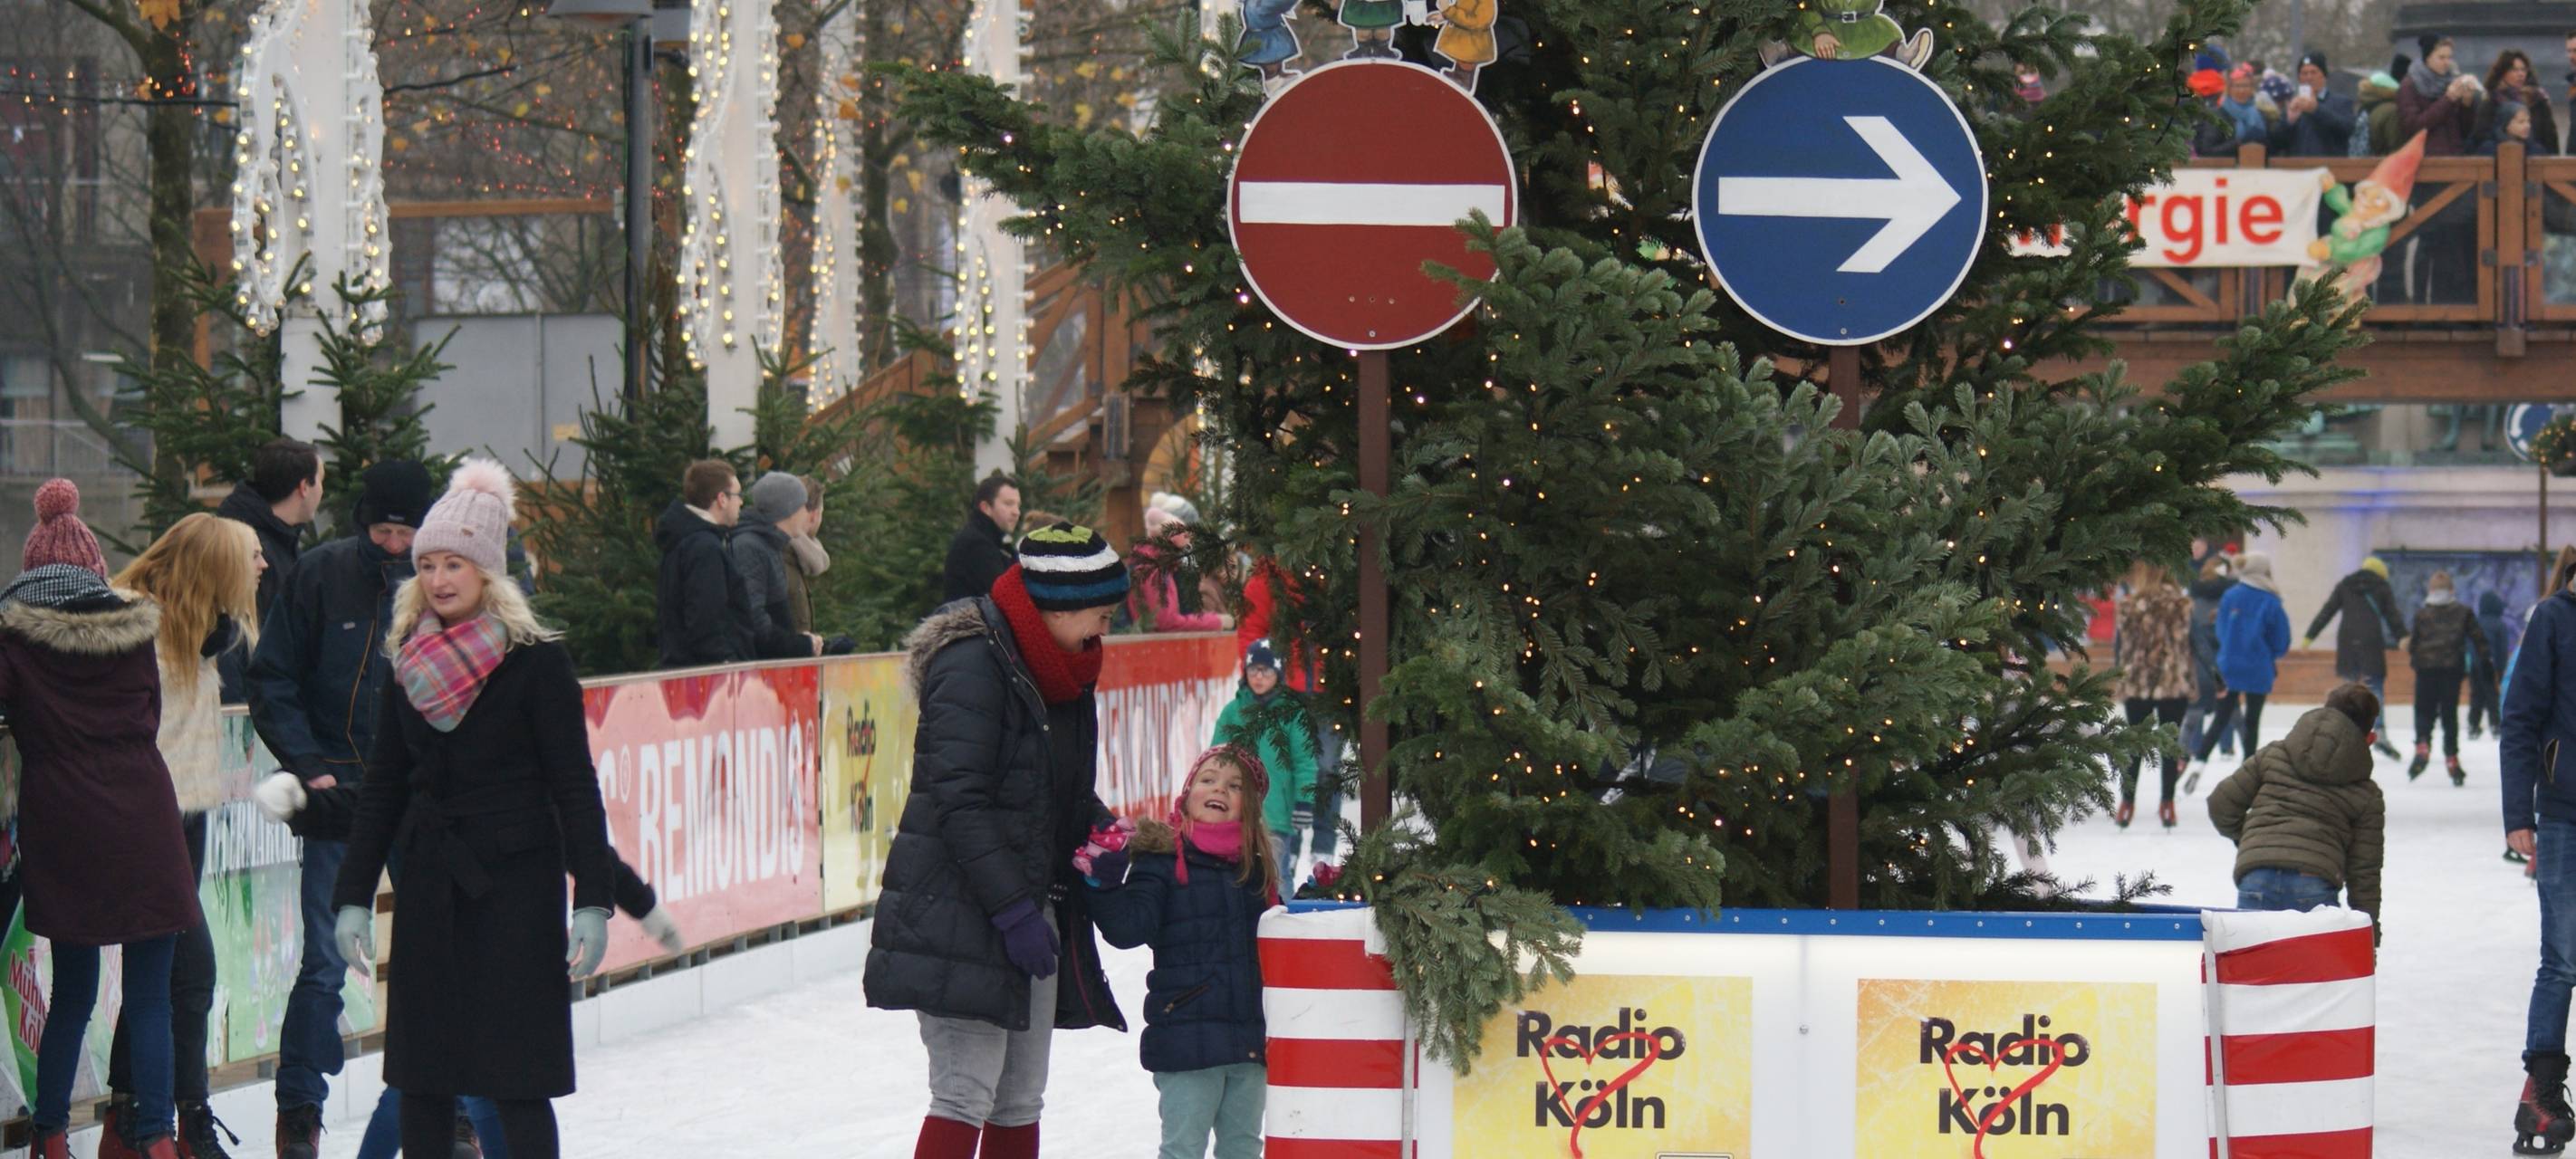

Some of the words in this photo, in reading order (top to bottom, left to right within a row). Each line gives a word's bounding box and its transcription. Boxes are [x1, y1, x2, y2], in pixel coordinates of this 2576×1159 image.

[2018, 178, 2284, 264] rgie
[18, 1000, 42, 1056] Köl
[1516, 1007, 1687, 1060] Radio
[1919, 1013, 2091, 1067] Radio
[1535, 1079, 1666, 1129] Köln
[1938, 1086, 2070, 1135] Köln
